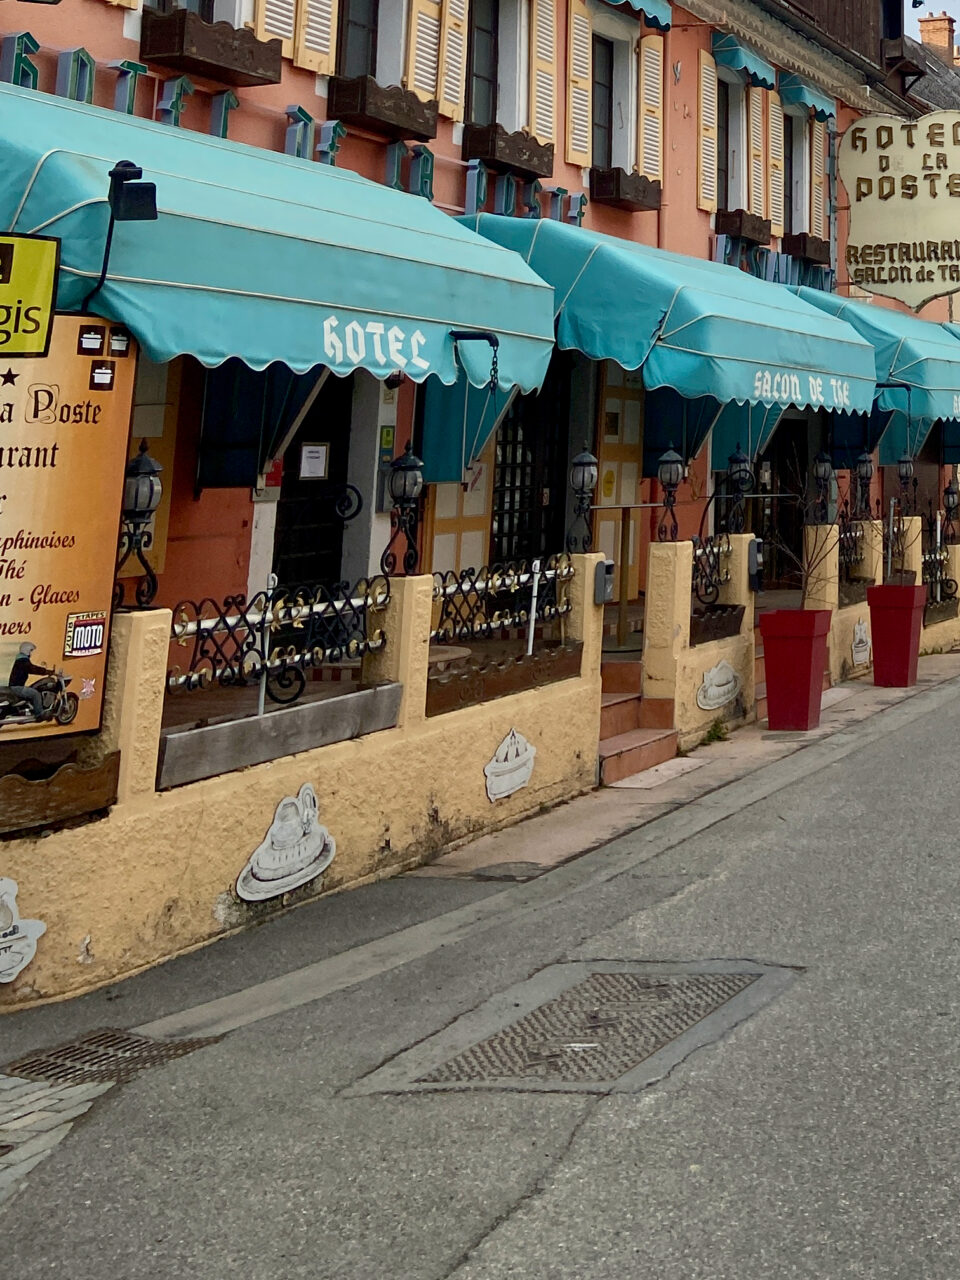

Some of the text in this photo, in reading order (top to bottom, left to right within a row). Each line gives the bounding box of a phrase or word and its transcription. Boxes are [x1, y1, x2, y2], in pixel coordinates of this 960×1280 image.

[922, 152, 948, 171] LA
[465, 158, 588, 228] POSTE
[853, 266, 912, 285] SALON
[915, 269, 935, 283] de
[323, 315, 431, 370] HOTEL
[754, 370, 850, 406] SALON DE THE
[25, 383, 102, 424] Poste
[0, 529, 76, 557] phinoises
[30, 584, 80, 612] Glaces
[73, 624, 104, 649] MOTO
